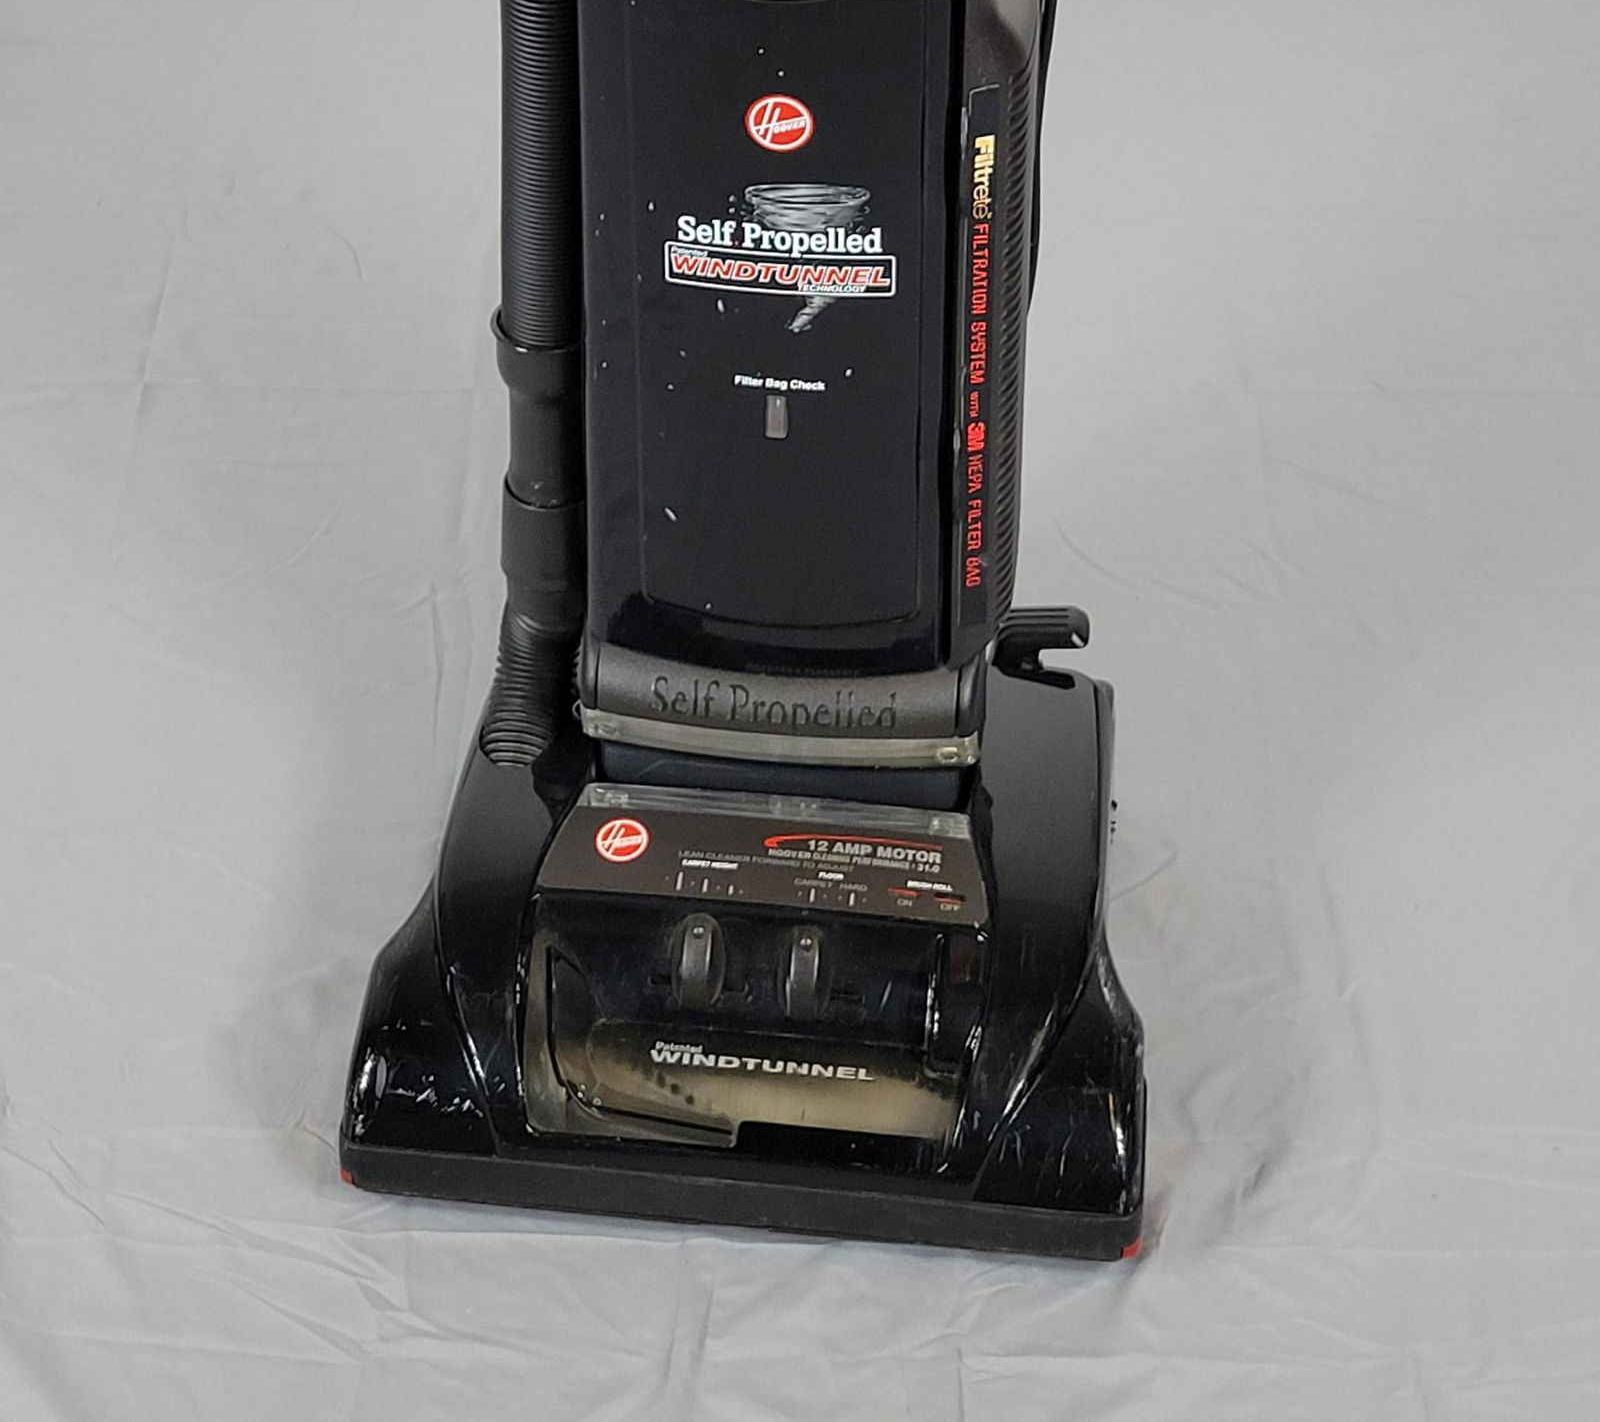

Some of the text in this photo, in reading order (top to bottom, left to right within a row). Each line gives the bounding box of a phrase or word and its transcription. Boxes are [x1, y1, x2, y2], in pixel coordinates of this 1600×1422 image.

[678, 216, 883, 258] Self Propelled
[671, 253, 891, 287] WINDTUNNEL
[971, 223, 989, 315] FILTRATION
[797, 283, 866, 293] TECHNOLOGY
[969, 321, 987, 384] SYSTEM
[734, 374, 826, 391] Filter Bag Check
[967, 421, 986, 452] 3M
[967, 454, 984, 493] HEPA
[967, 499, 983, 552] FILTER
[965, 557, 983, 588] BAG
[651, 675, 896, 729] Self Propelled
[678, 849, 705, 859] LEAN
[706, 851, 751, 863] CLEANER
[802, 860, 816, 870] TO
[767, 848, 811, 860] HOOVER
[916, 862, 941, 874] 31.0
[807, 839, 943, 865] 12 AMP MOTOR
[839, 882, 868, 893] HARD
[896, 897, 913, 908] ON
[655, 1040, 703, 1054] Patented
[650, 1048, 876, 1081] WINDTUNNEL
